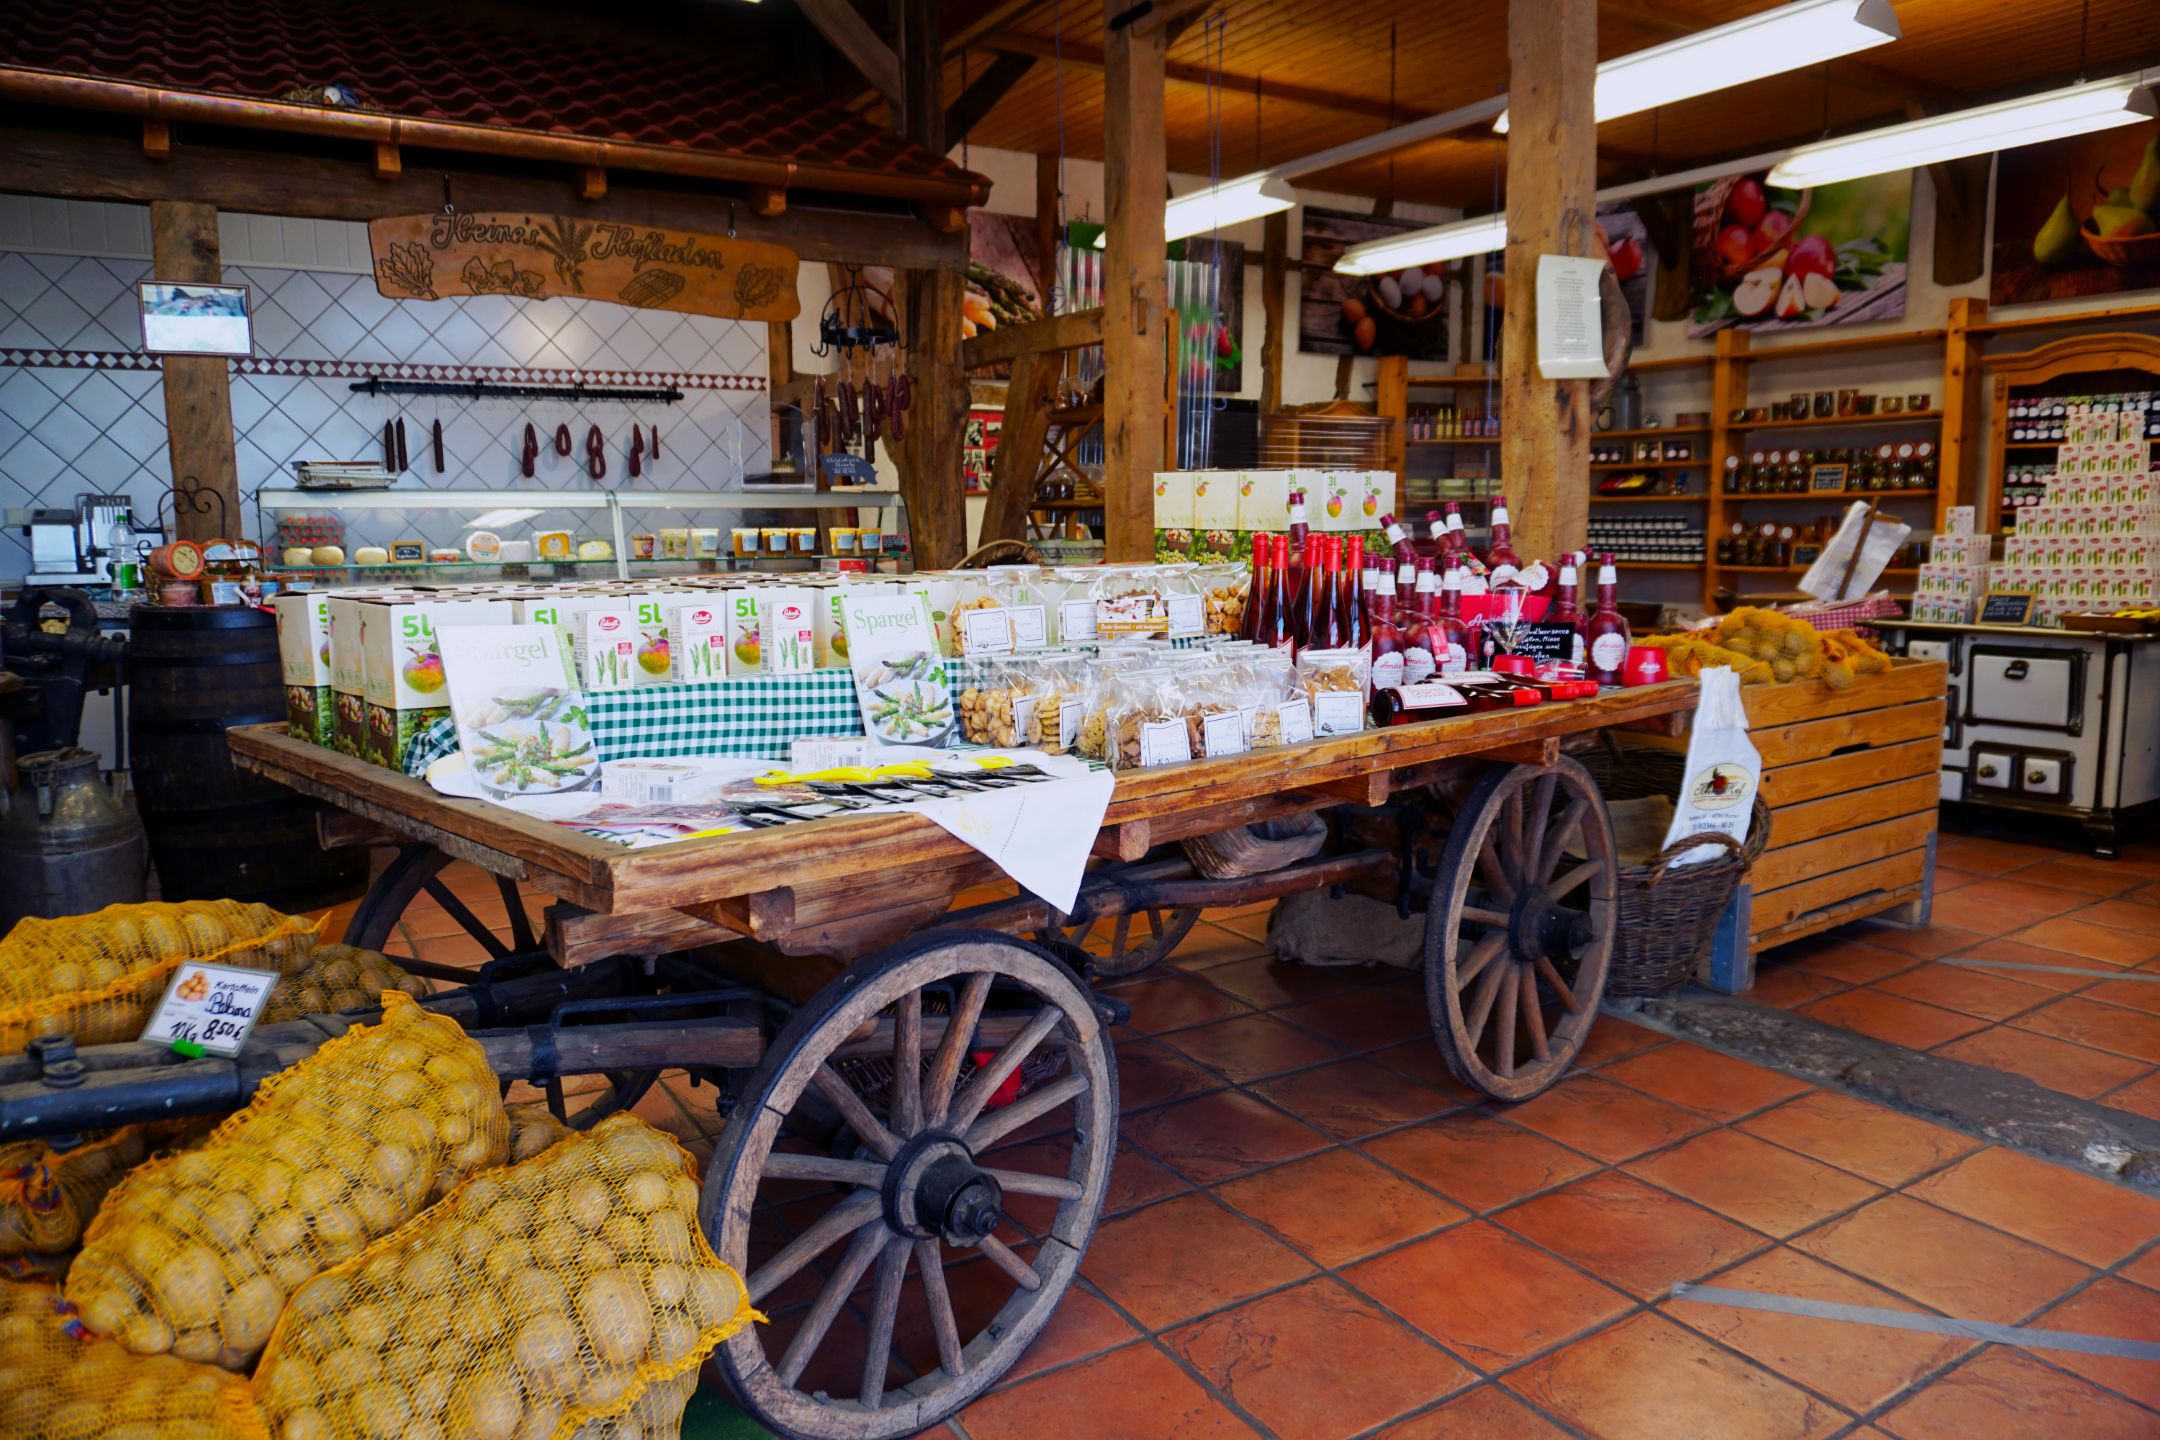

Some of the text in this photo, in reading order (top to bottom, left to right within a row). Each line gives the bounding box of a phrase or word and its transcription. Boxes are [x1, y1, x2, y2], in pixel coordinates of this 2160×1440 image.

[431, 213, 724, 272] Heine's Hofladen
[639, 603, 663, 624] 5l
[736, 597, 759, 617] 5l
[402, 614, 433, 637] 5l
[854, 606, 920, 636] Spargel
[214, 981, 260, 995] Kartoffeln
